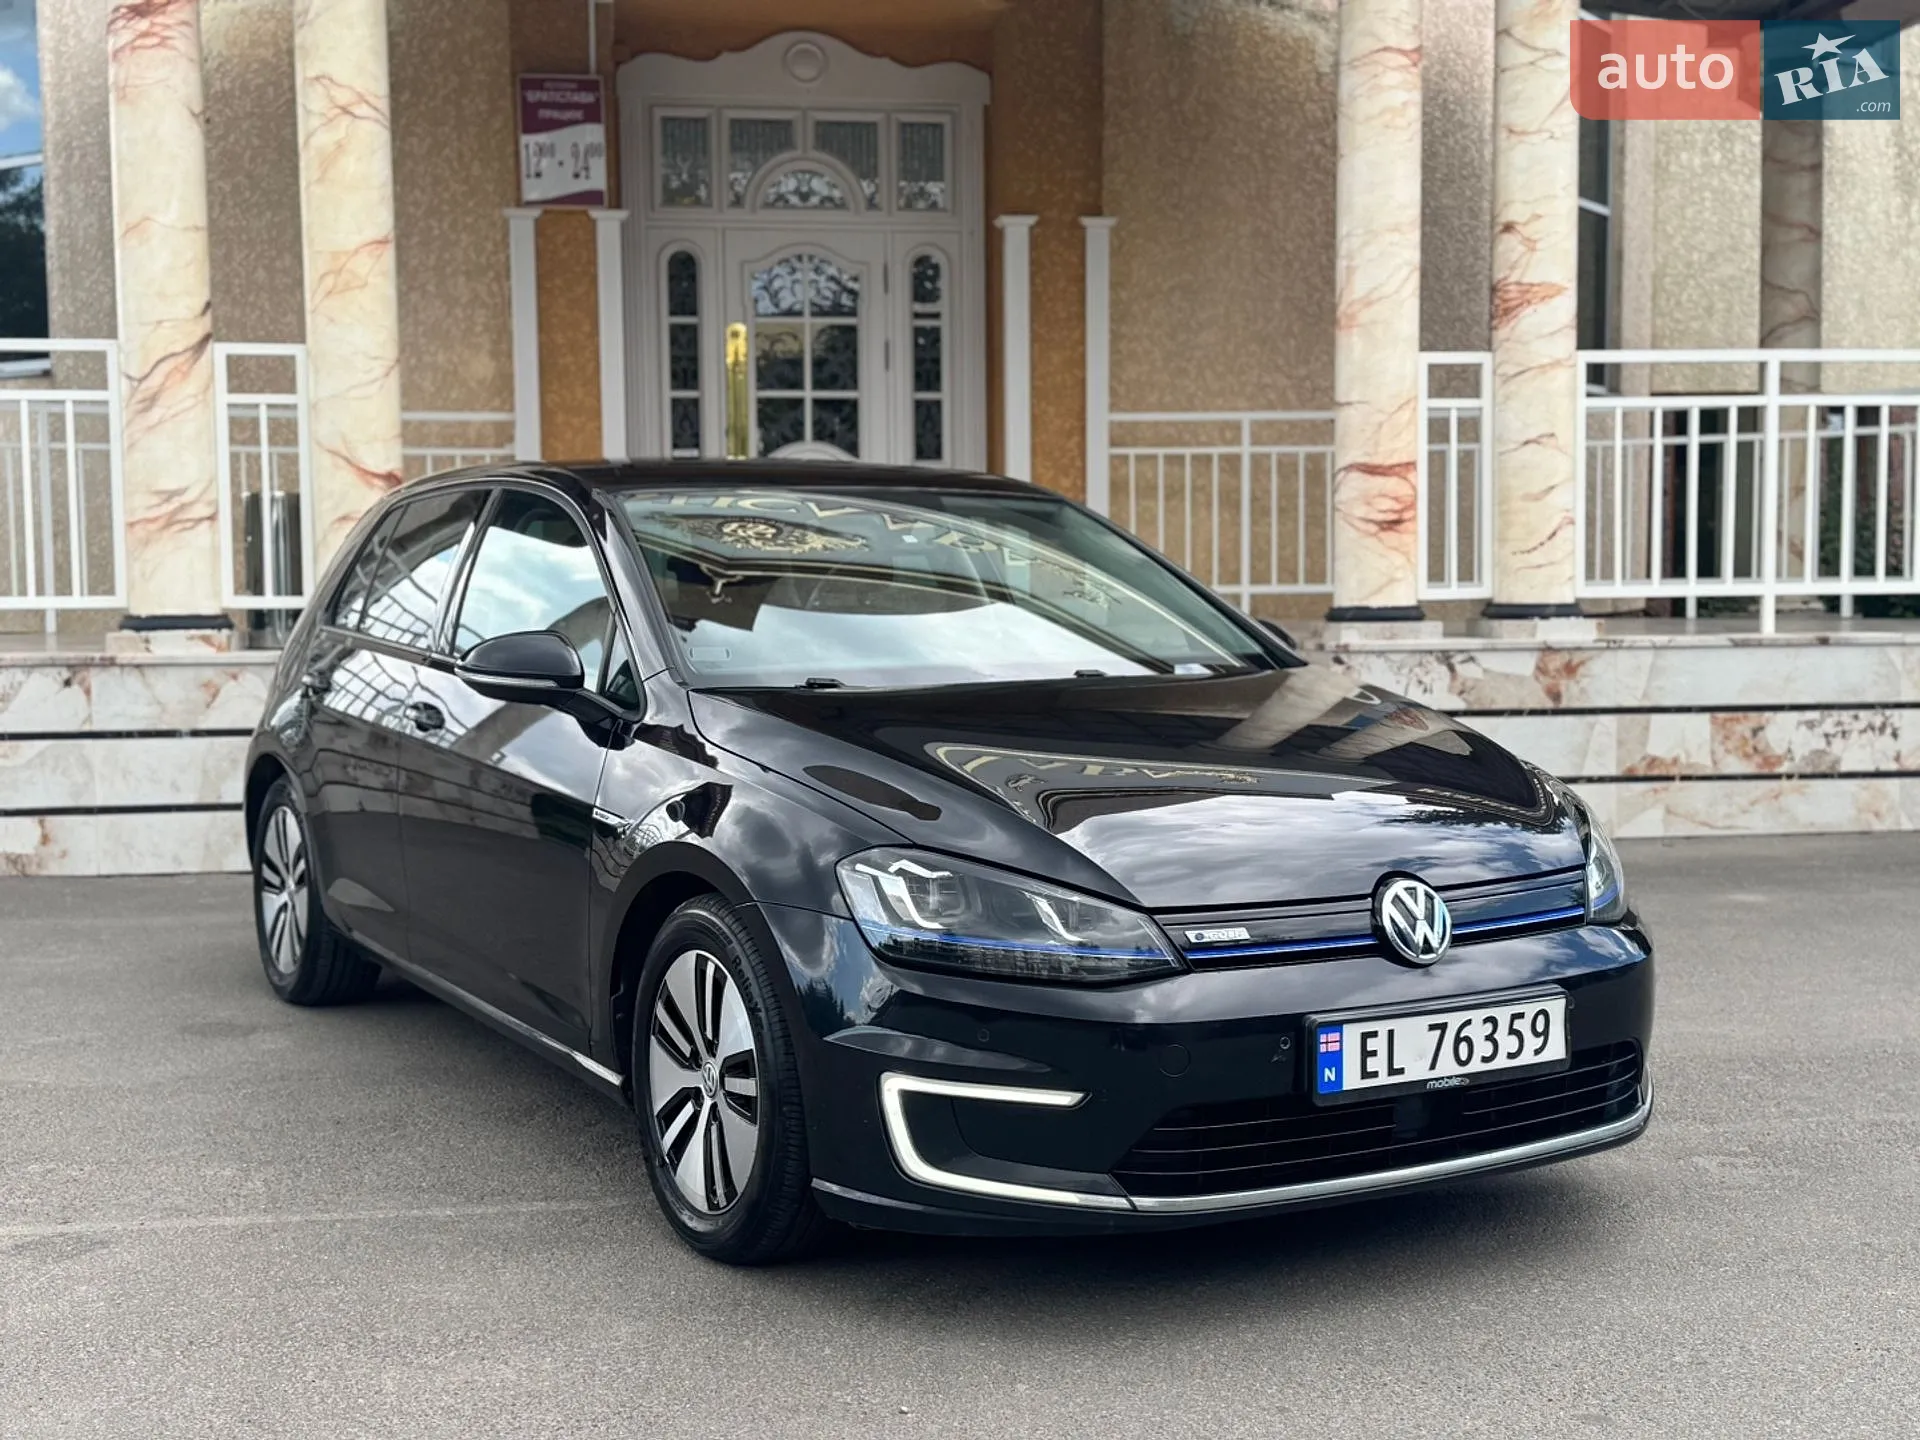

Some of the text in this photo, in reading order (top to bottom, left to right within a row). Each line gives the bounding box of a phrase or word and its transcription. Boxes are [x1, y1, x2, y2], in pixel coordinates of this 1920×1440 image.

[1360, 1008, 1551, 1080] EL 76359
[1324, 1067, 1336, 1083] N
